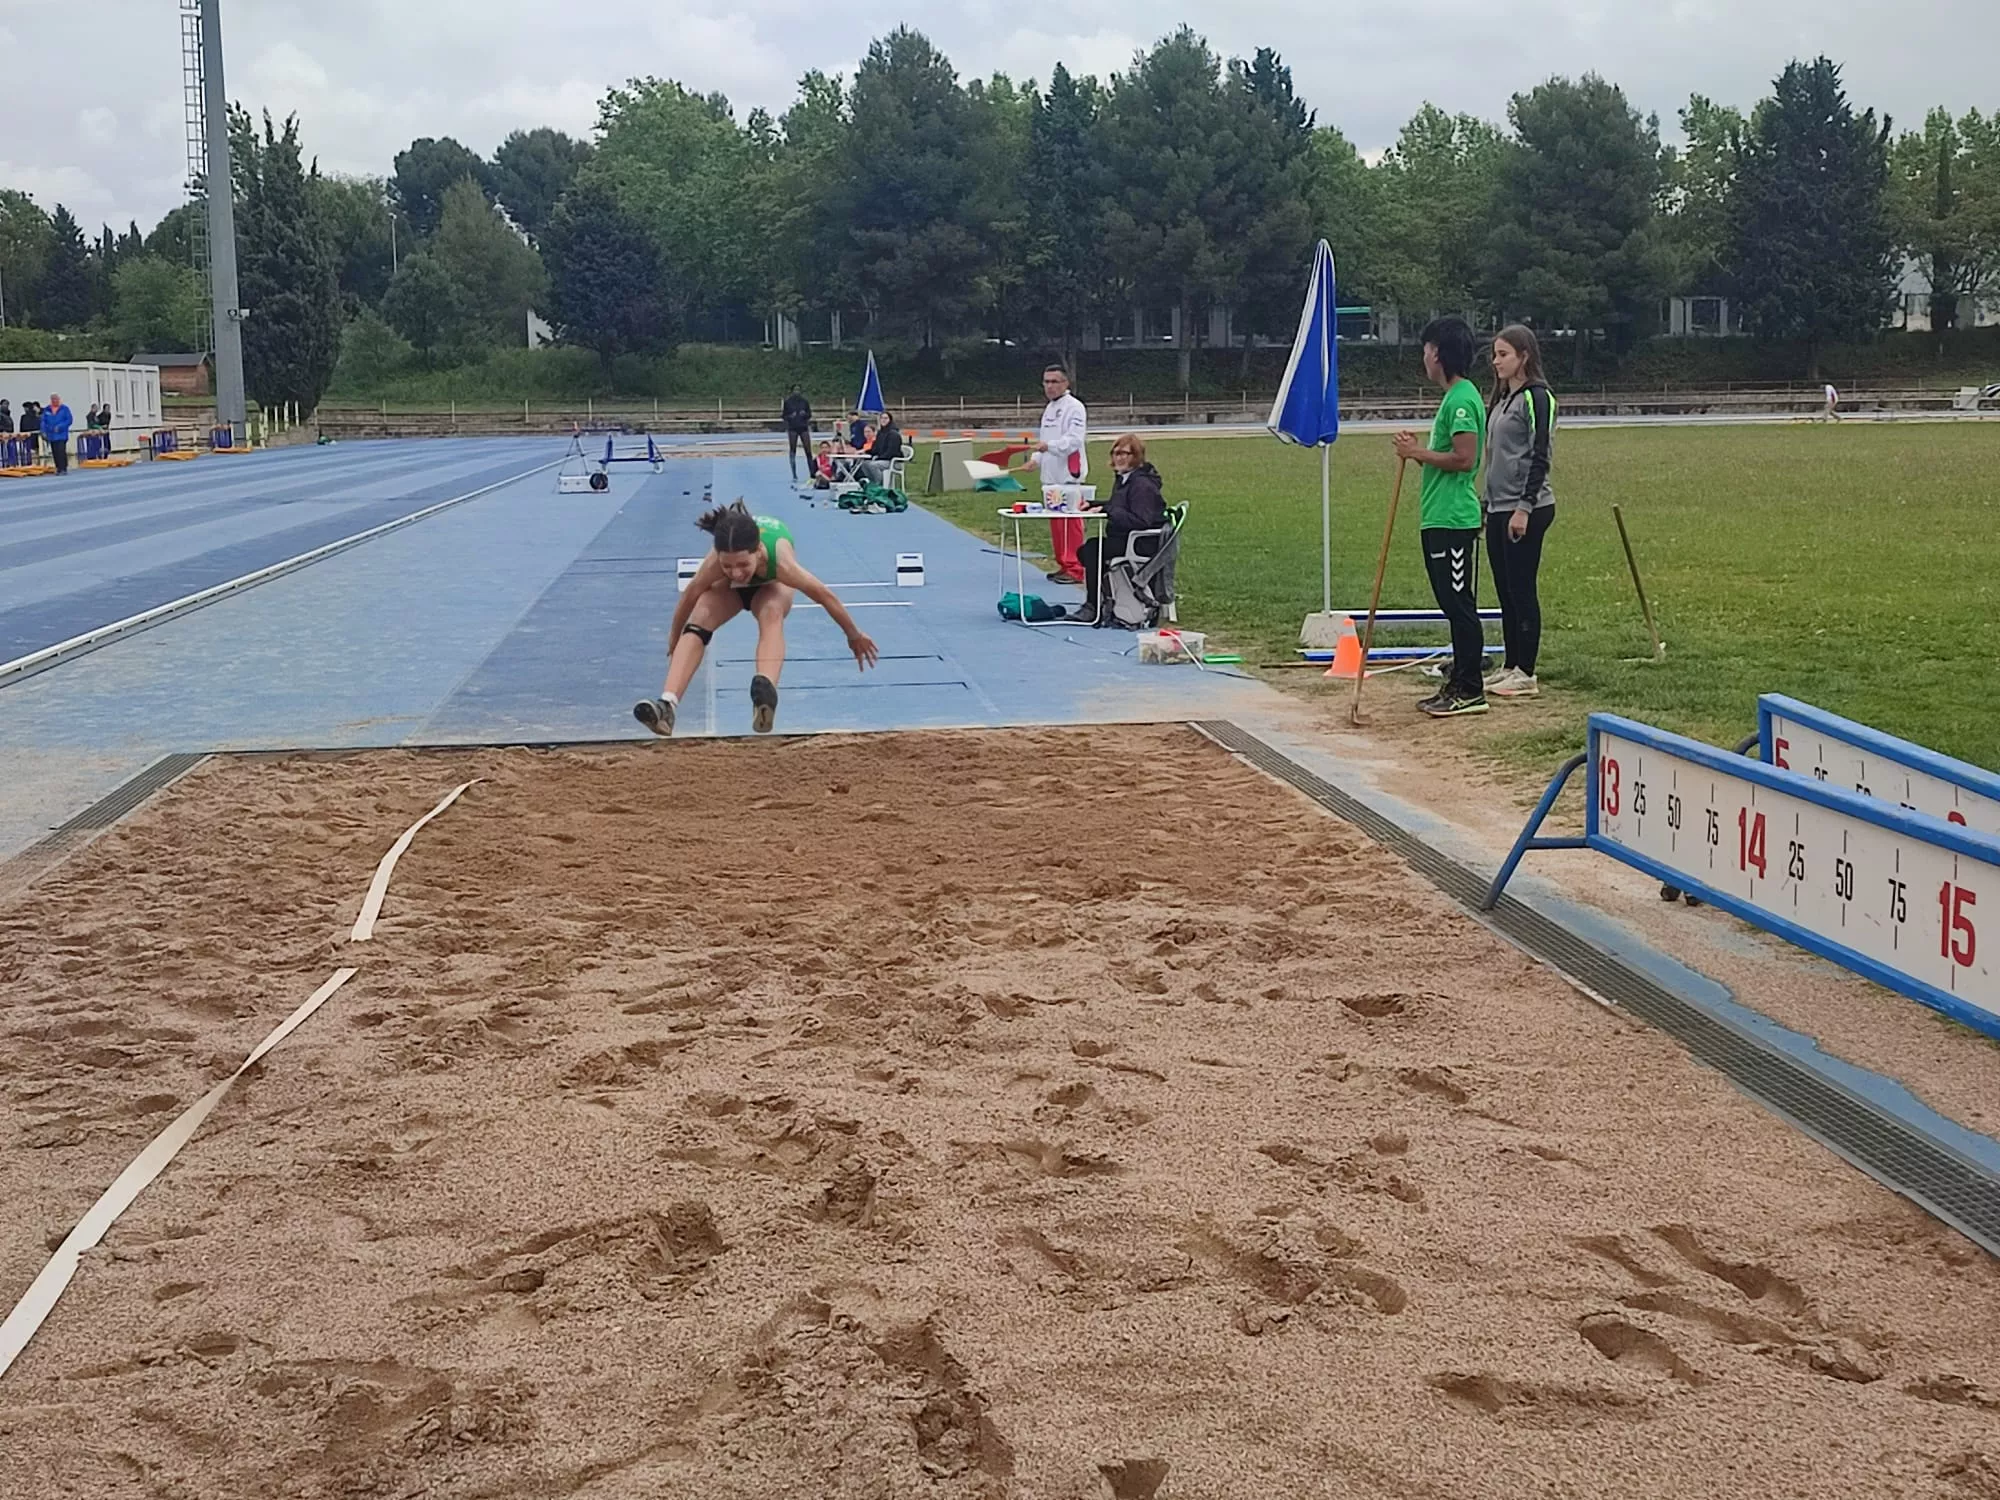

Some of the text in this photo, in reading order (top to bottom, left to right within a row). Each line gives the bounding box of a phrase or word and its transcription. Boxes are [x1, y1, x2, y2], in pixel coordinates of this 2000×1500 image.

[1599, 755, 1977, 968] 13 25 50 75 14 25 50 75 15
